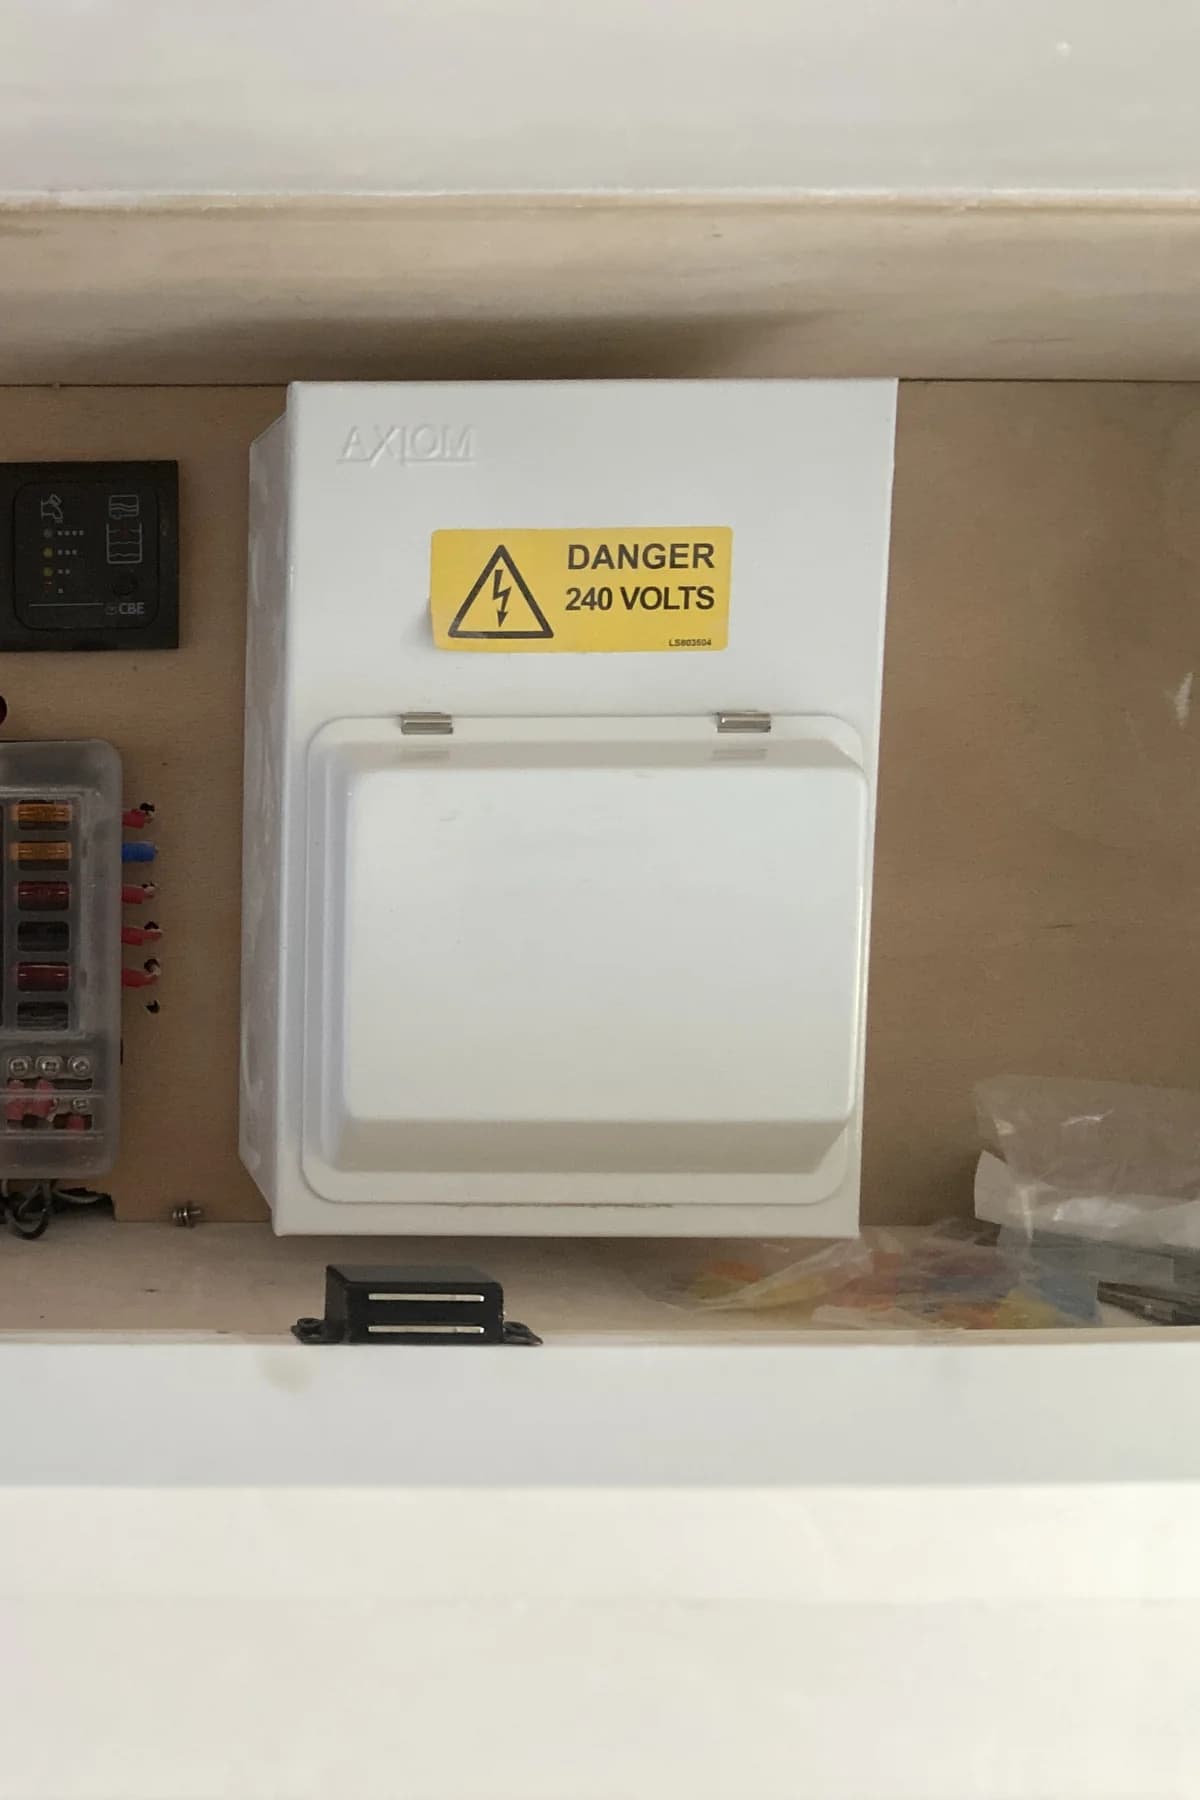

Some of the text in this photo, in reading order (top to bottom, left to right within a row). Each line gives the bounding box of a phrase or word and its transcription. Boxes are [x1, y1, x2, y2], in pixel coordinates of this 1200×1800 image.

[341, 423, 475, 463] AXIOM
[567, 543, 715, 570] DANGER
[118, 602, 145, 615] CBE
[565, 585, 715, 611] 240 VOLTS
